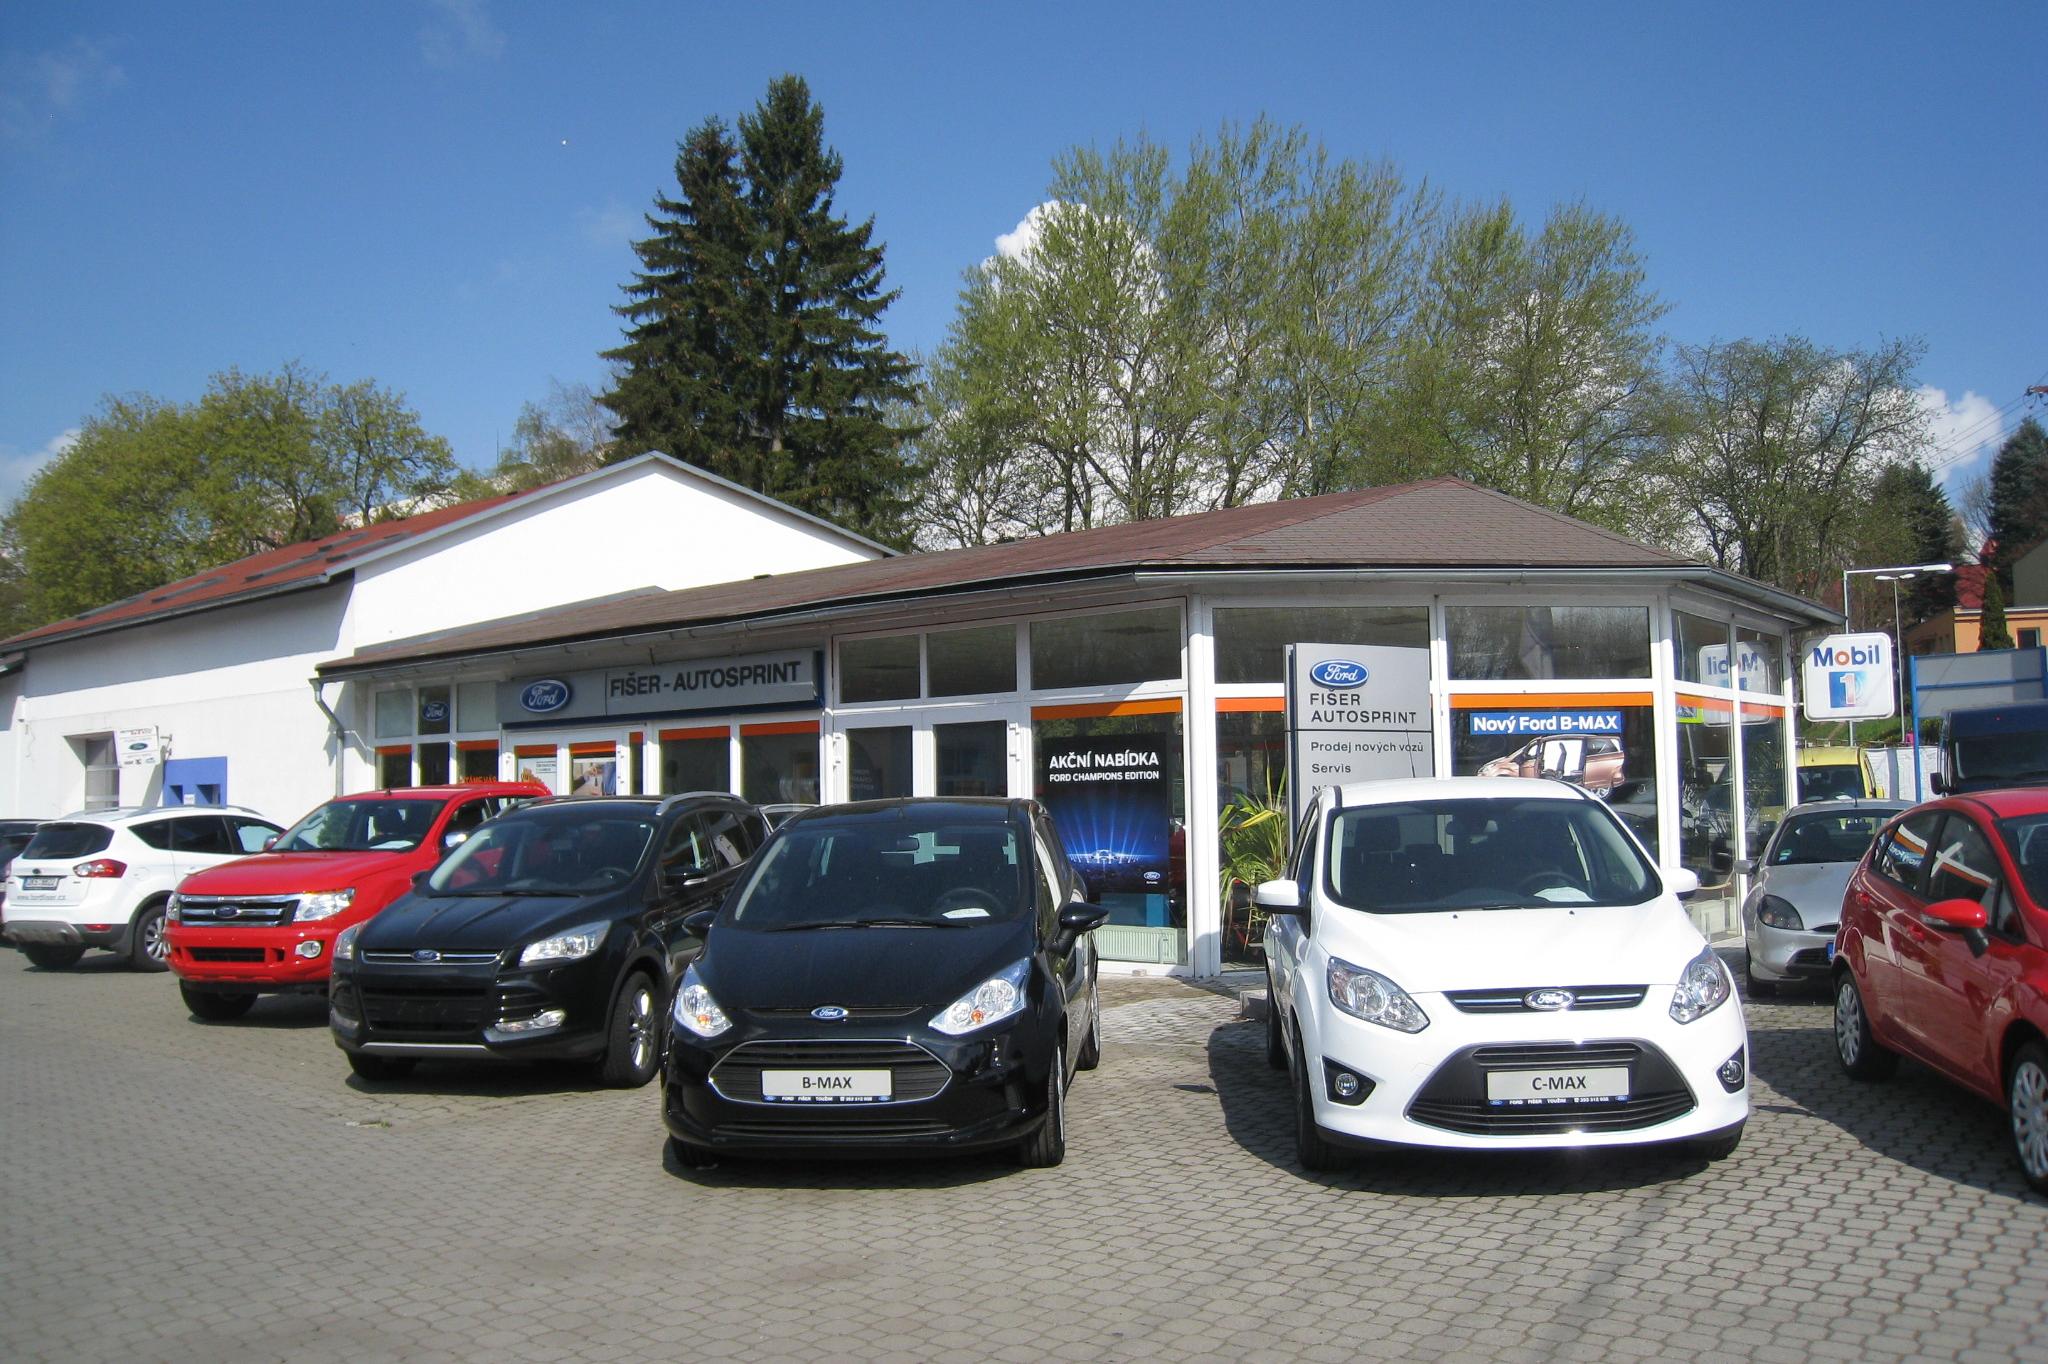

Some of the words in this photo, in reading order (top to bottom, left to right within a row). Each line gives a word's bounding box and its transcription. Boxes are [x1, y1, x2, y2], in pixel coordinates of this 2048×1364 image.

[1813, 645, 1880, 668] Mobil
[610, 672, 661, 697] FIŠER
[673, 661, 801, 692] AUTOSPRINT
[1323, 662, 1359, 682] Ford
[528, 685, 559, 706] Ford
[1310, 689, 1361, 706] FIŠER
[1840, 672, 1857, 705] 1
[1311, 710, 1417, 724] AUTOSPRINT
[1473, 715, 1516, 734] Nový
[1519, 715, 1557, 731] Ford
[1560, 715, 1618, 730] B-MAX
[1310, 741, 1352, 753] Prodej
[1354, 741, 1397, 753] nových
[1399, 741, 1424, 752] vozů
[1049, 750, 1092, 769] AKČNÍ
[1094, 749, 1160, 768] NABÍDKA
[1311, 763, 1352, 773] Servis
[1049, 773, 1072, 783] FORD
[1072, 771, 1123, 782] CHAMPIONS
[1124, 770, 1160, 780] EDITION
[802, 1076, 852, 1089] B-MAX
[1532, 1076, 1587, 1090] C-MAX
